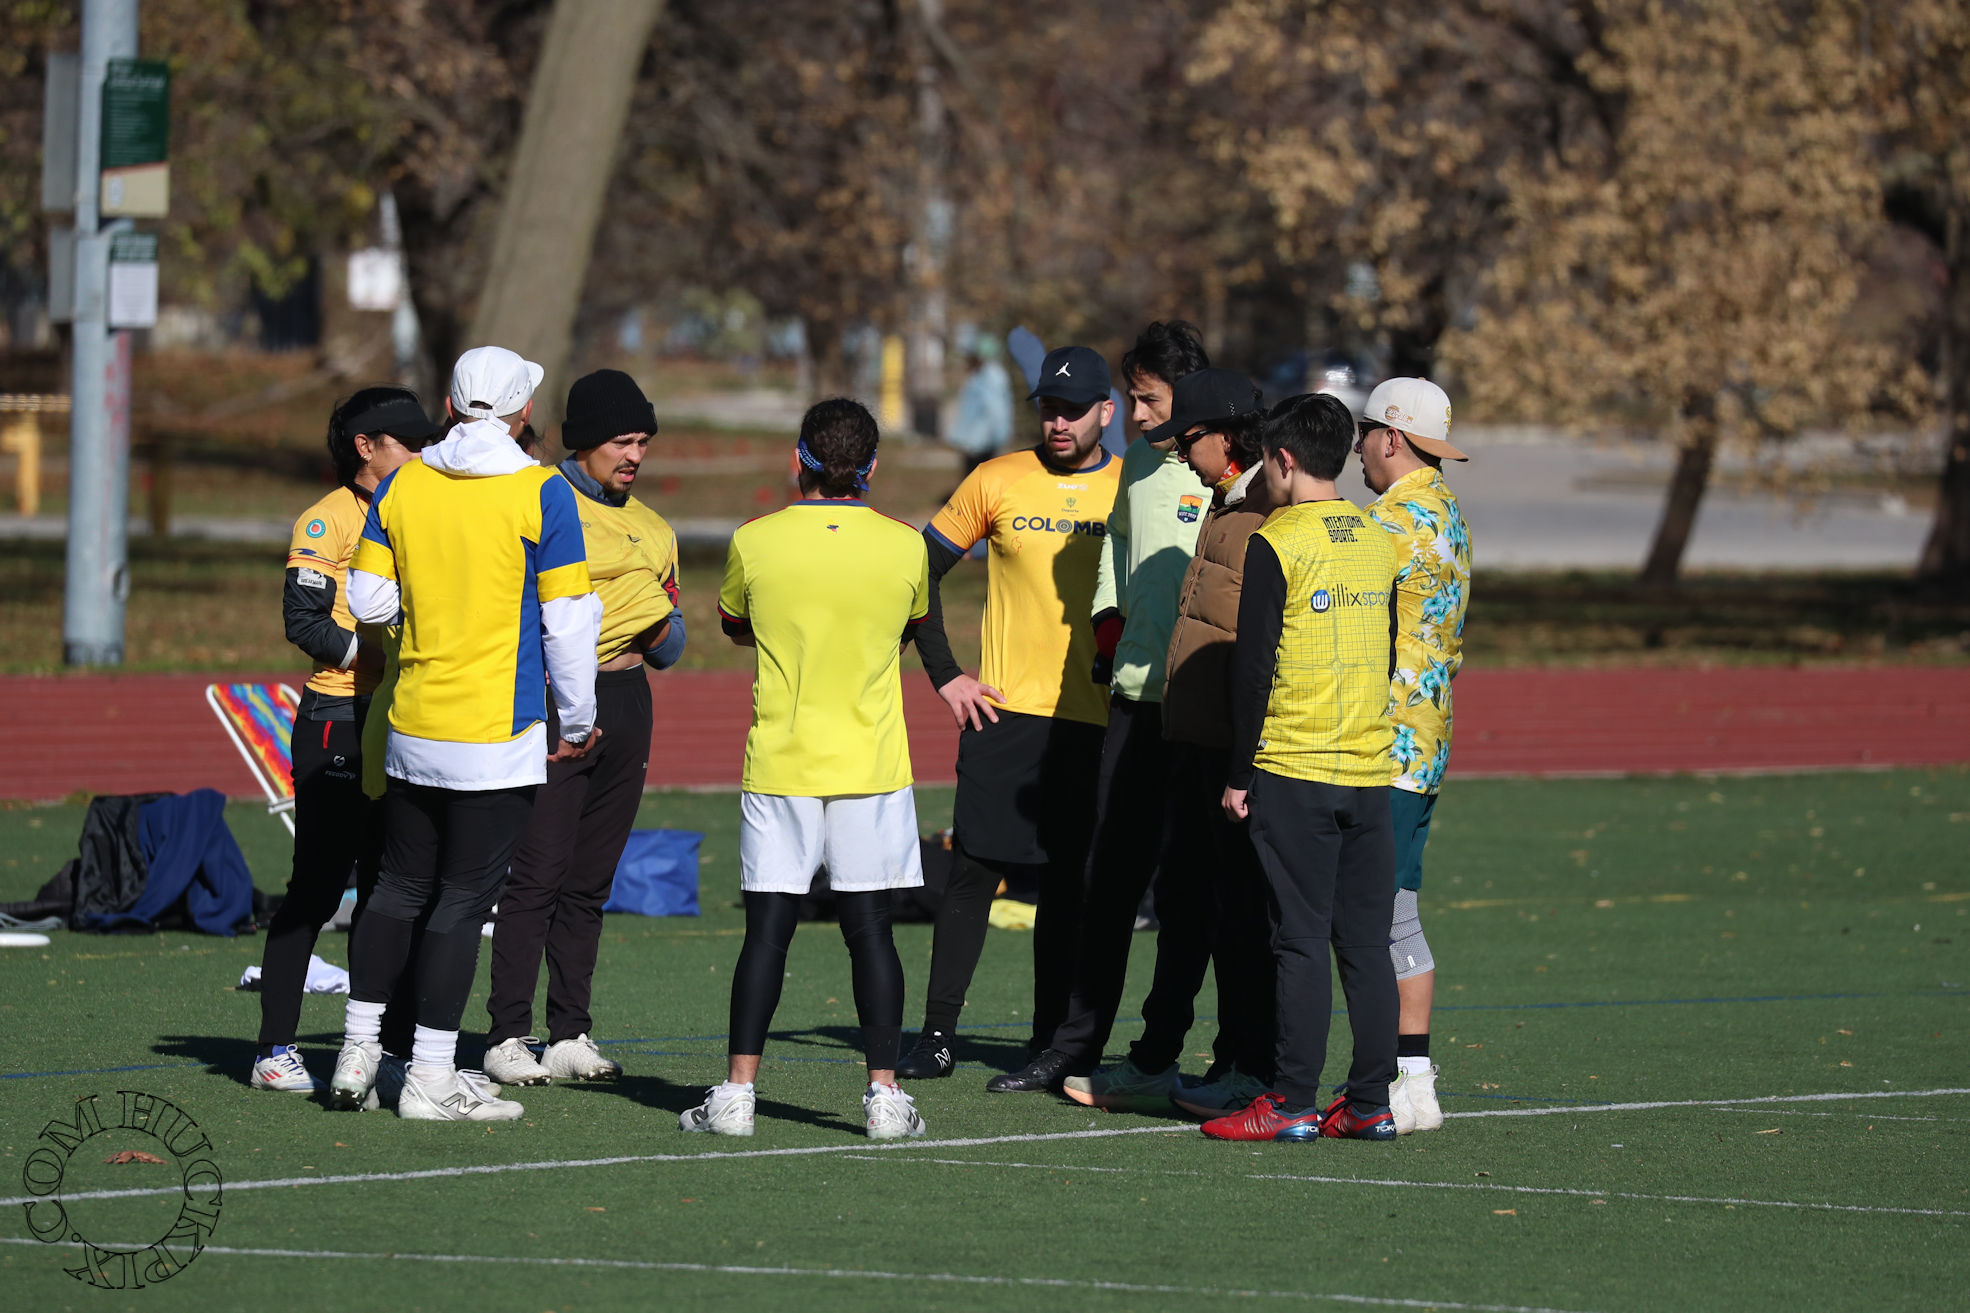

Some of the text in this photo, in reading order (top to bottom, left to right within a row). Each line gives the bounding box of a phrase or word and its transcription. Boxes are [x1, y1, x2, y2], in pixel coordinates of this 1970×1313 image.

[1322, 515, 1366, 528] INTENTIONAL
[1328, 529, 1358, 543] SPORTS.
[441, 1092, 484, 1116] N
